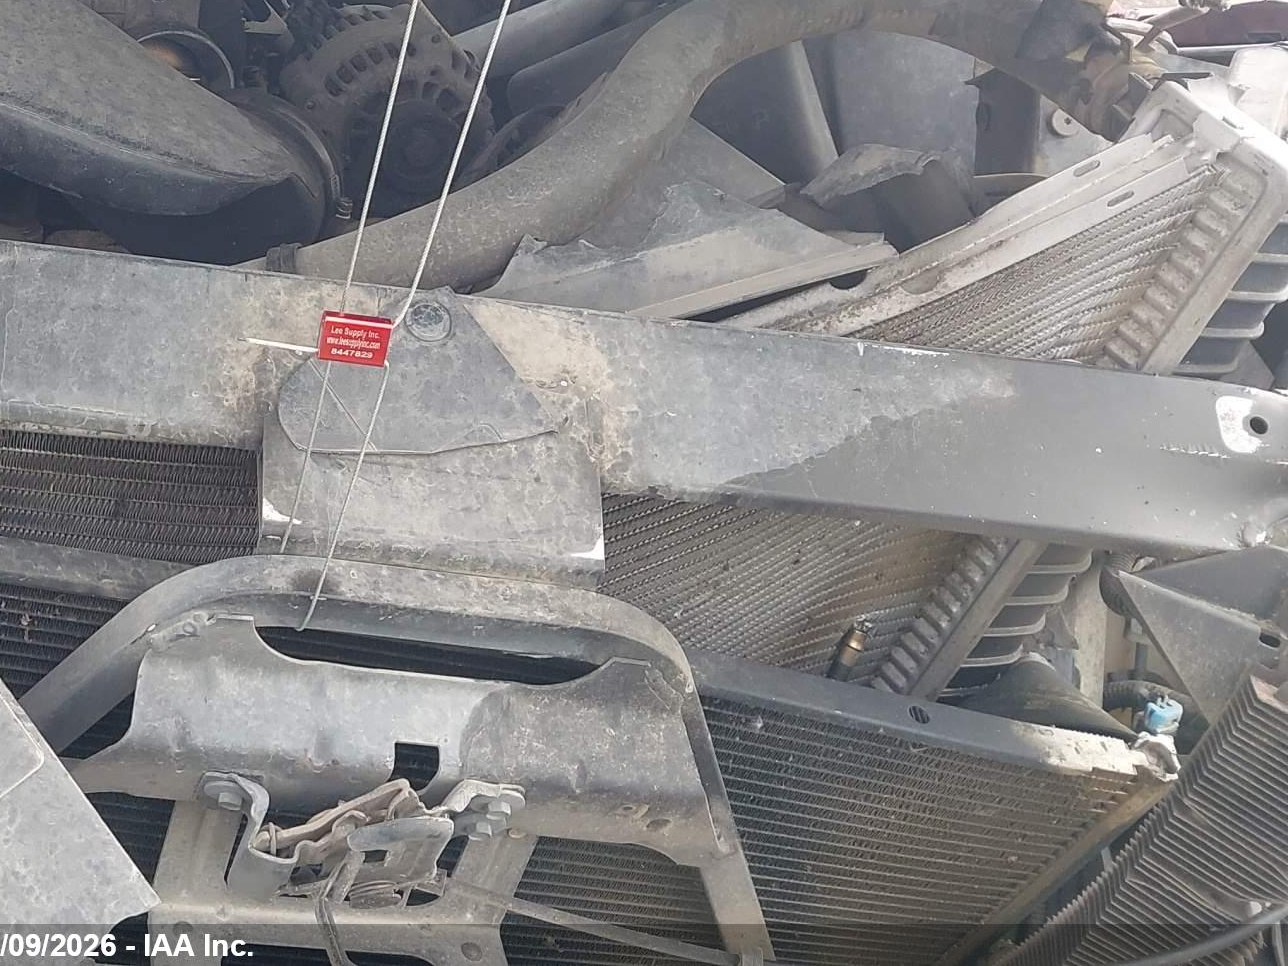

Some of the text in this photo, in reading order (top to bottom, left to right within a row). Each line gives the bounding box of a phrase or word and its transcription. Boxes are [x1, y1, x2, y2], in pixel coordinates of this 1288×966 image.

[331, 326, 380, 338] Lee Supply Inc.
[330, 348, 373, 358] 8447829
